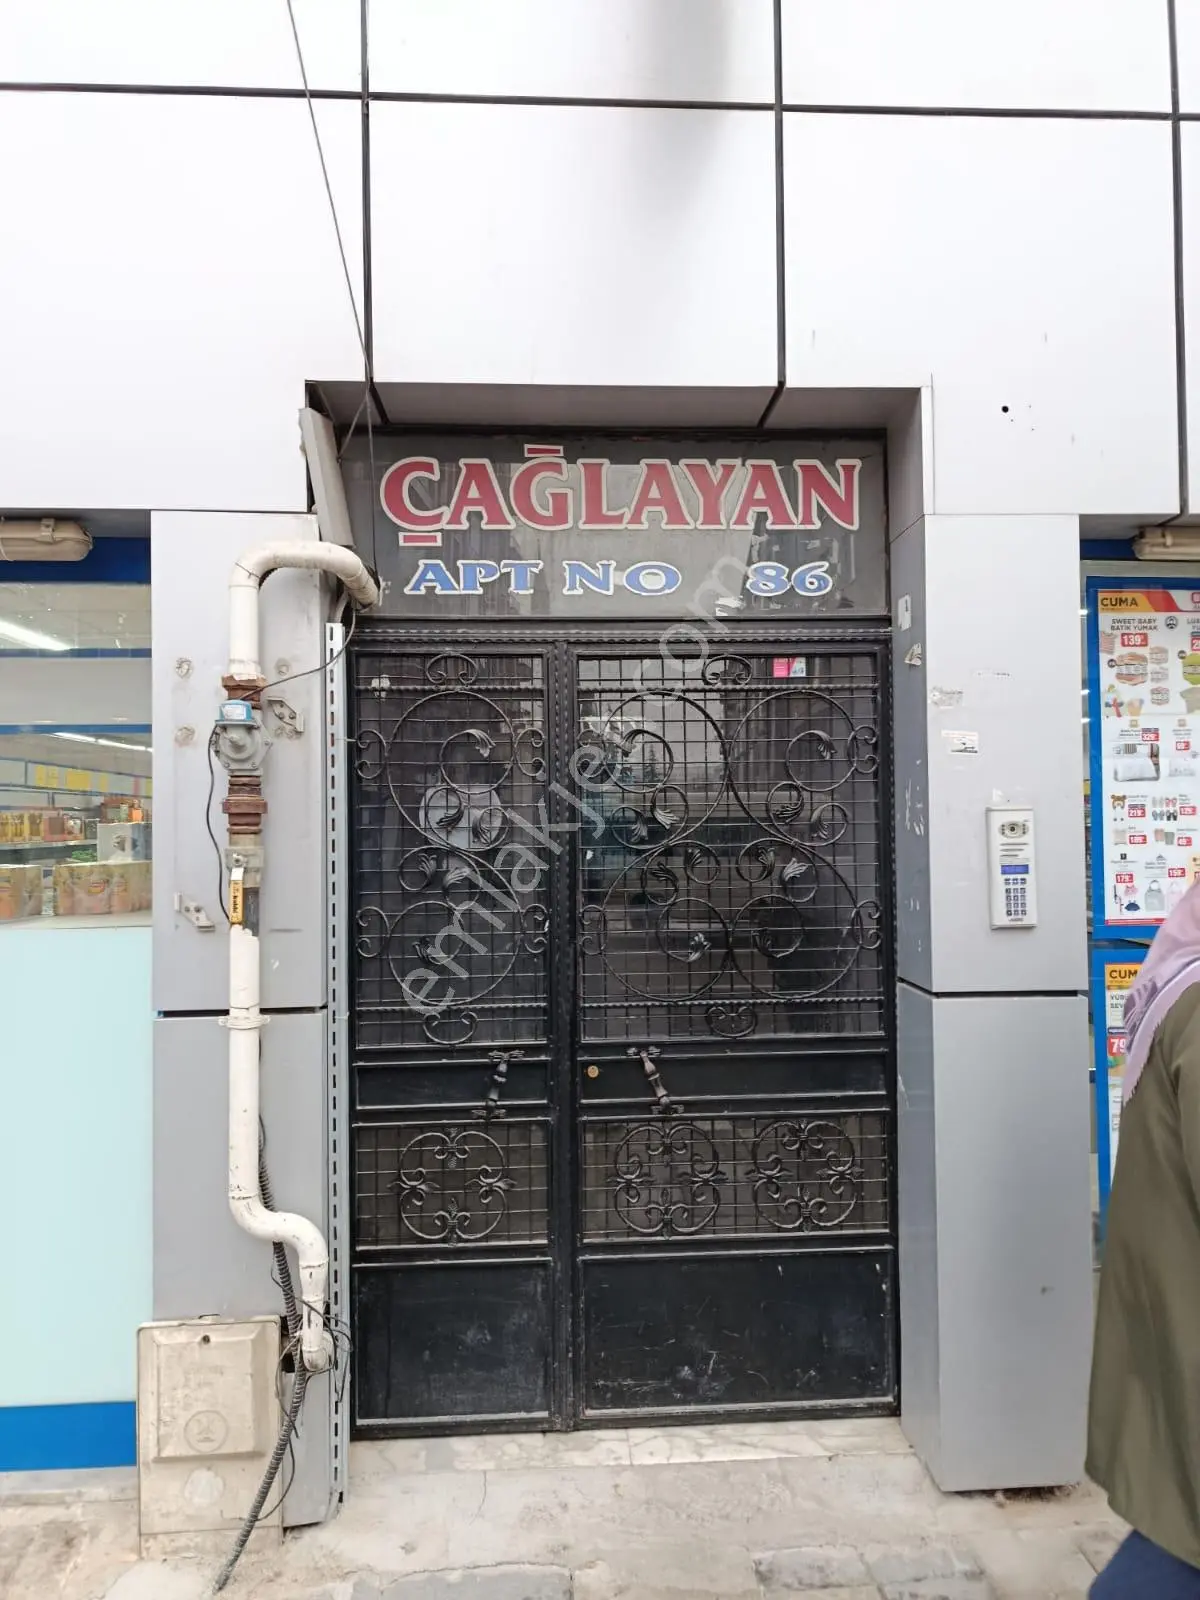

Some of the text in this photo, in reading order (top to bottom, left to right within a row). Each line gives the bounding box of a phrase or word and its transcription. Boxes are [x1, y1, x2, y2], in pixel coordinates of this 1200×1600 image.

[380, 443, 863, 547] ÇAĞLAYAN
[404, 559, 834, 597] APT NO 86
[1100, 597, 1138, 607] CUMA
[1109, 969, 1138, 980] CUM
